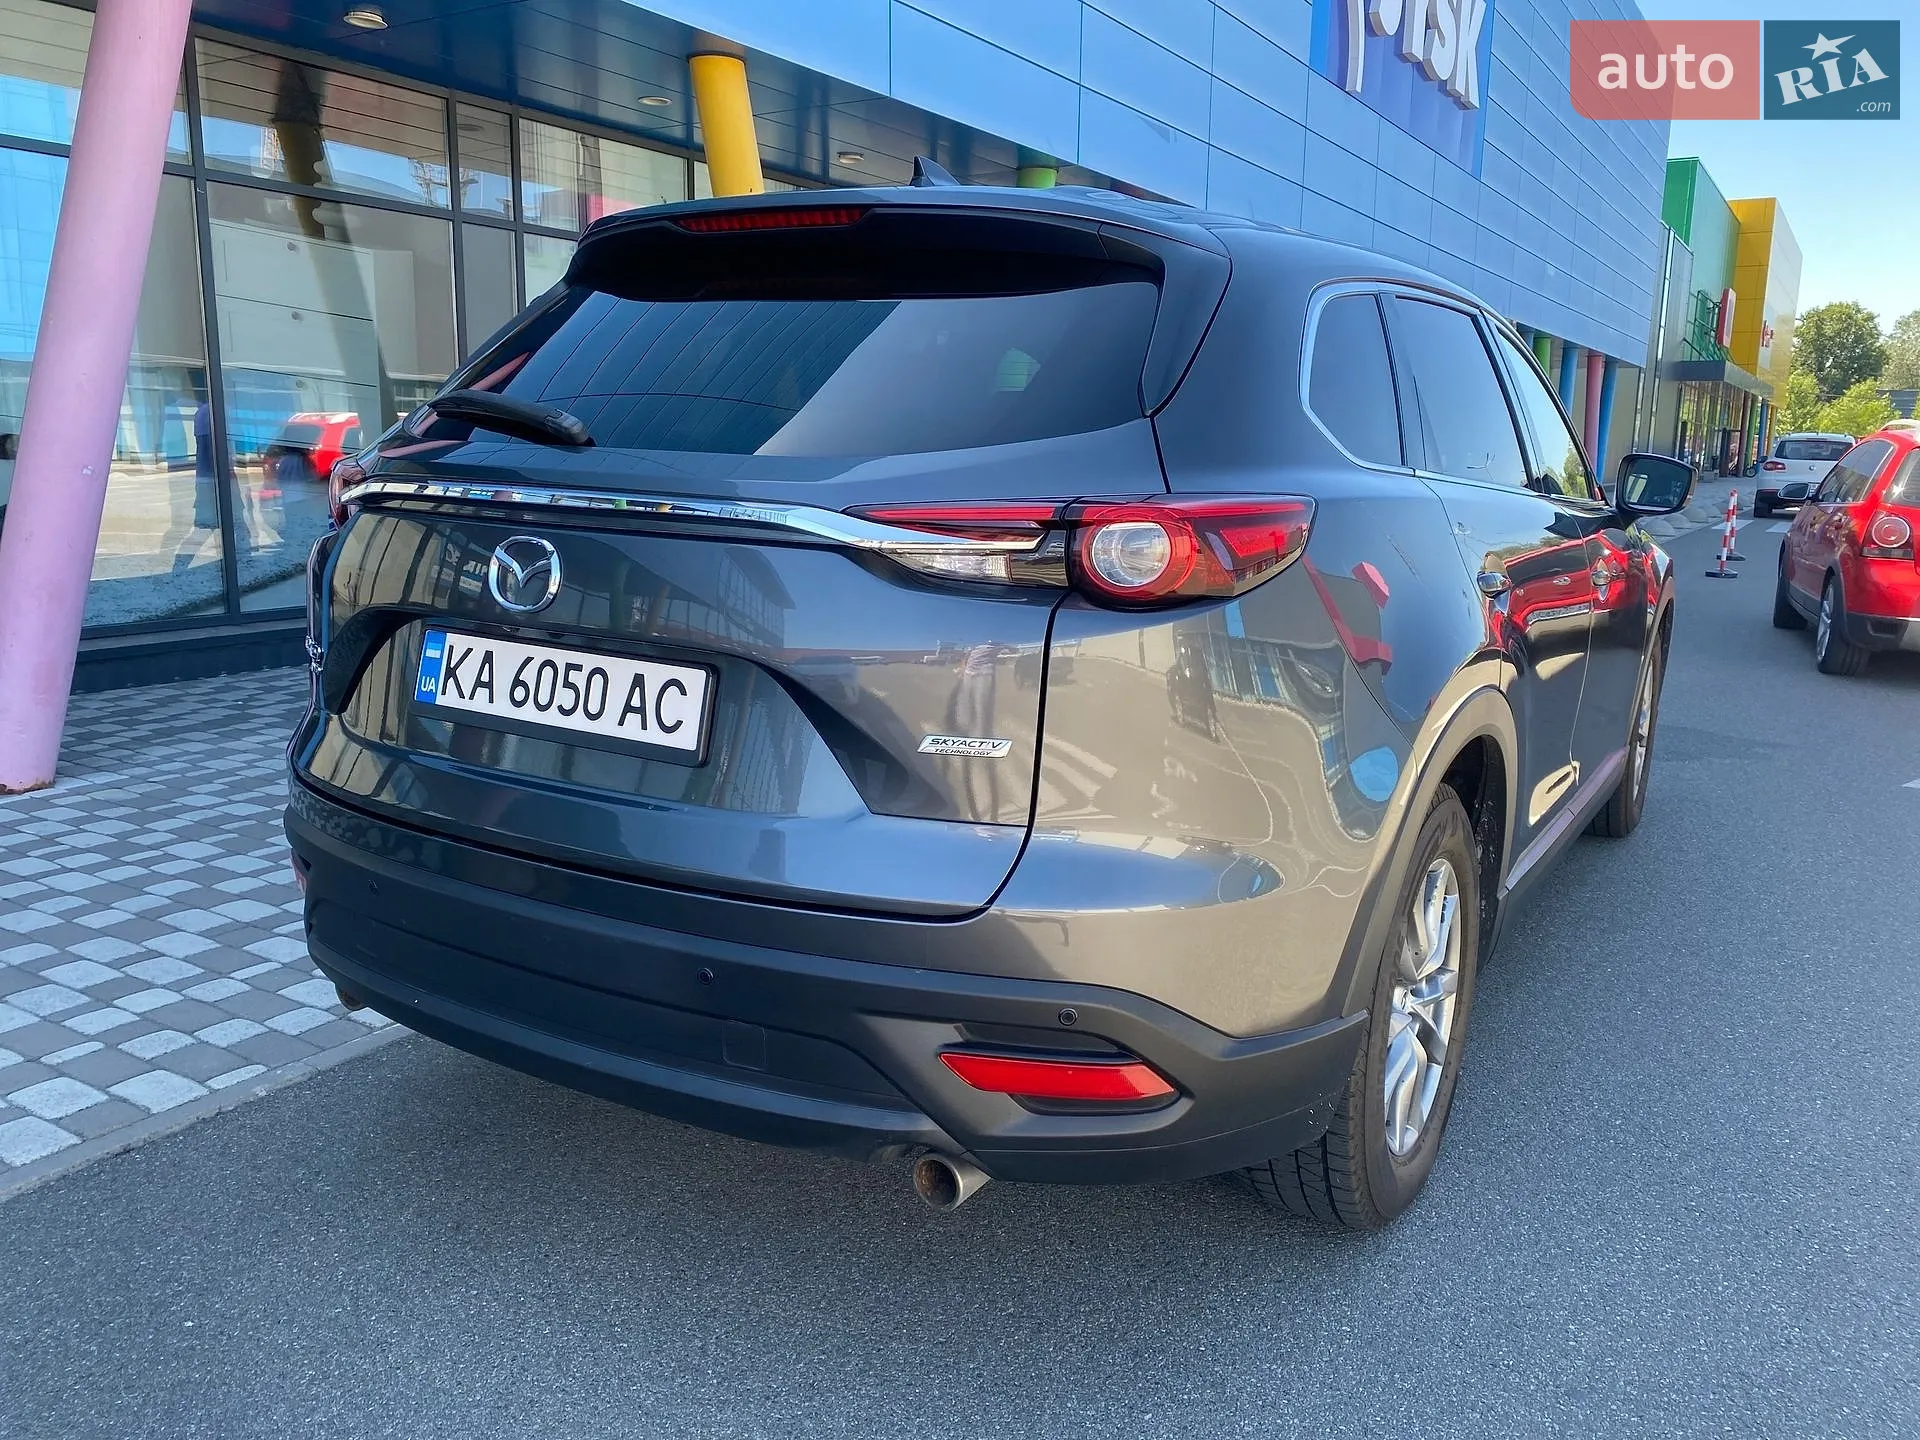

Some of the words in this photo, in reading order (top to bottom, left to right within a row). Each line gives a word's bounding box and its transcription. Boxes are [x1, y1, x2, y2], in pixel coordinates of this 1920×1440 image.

[421, 676, 436, 693] UA
[441, 644, 495, 704] KA
[508, 656, 609, 721] 6050
[617, 673, 688, 734] AC
[934, 748, 993, 756] TECHNOLOGY
